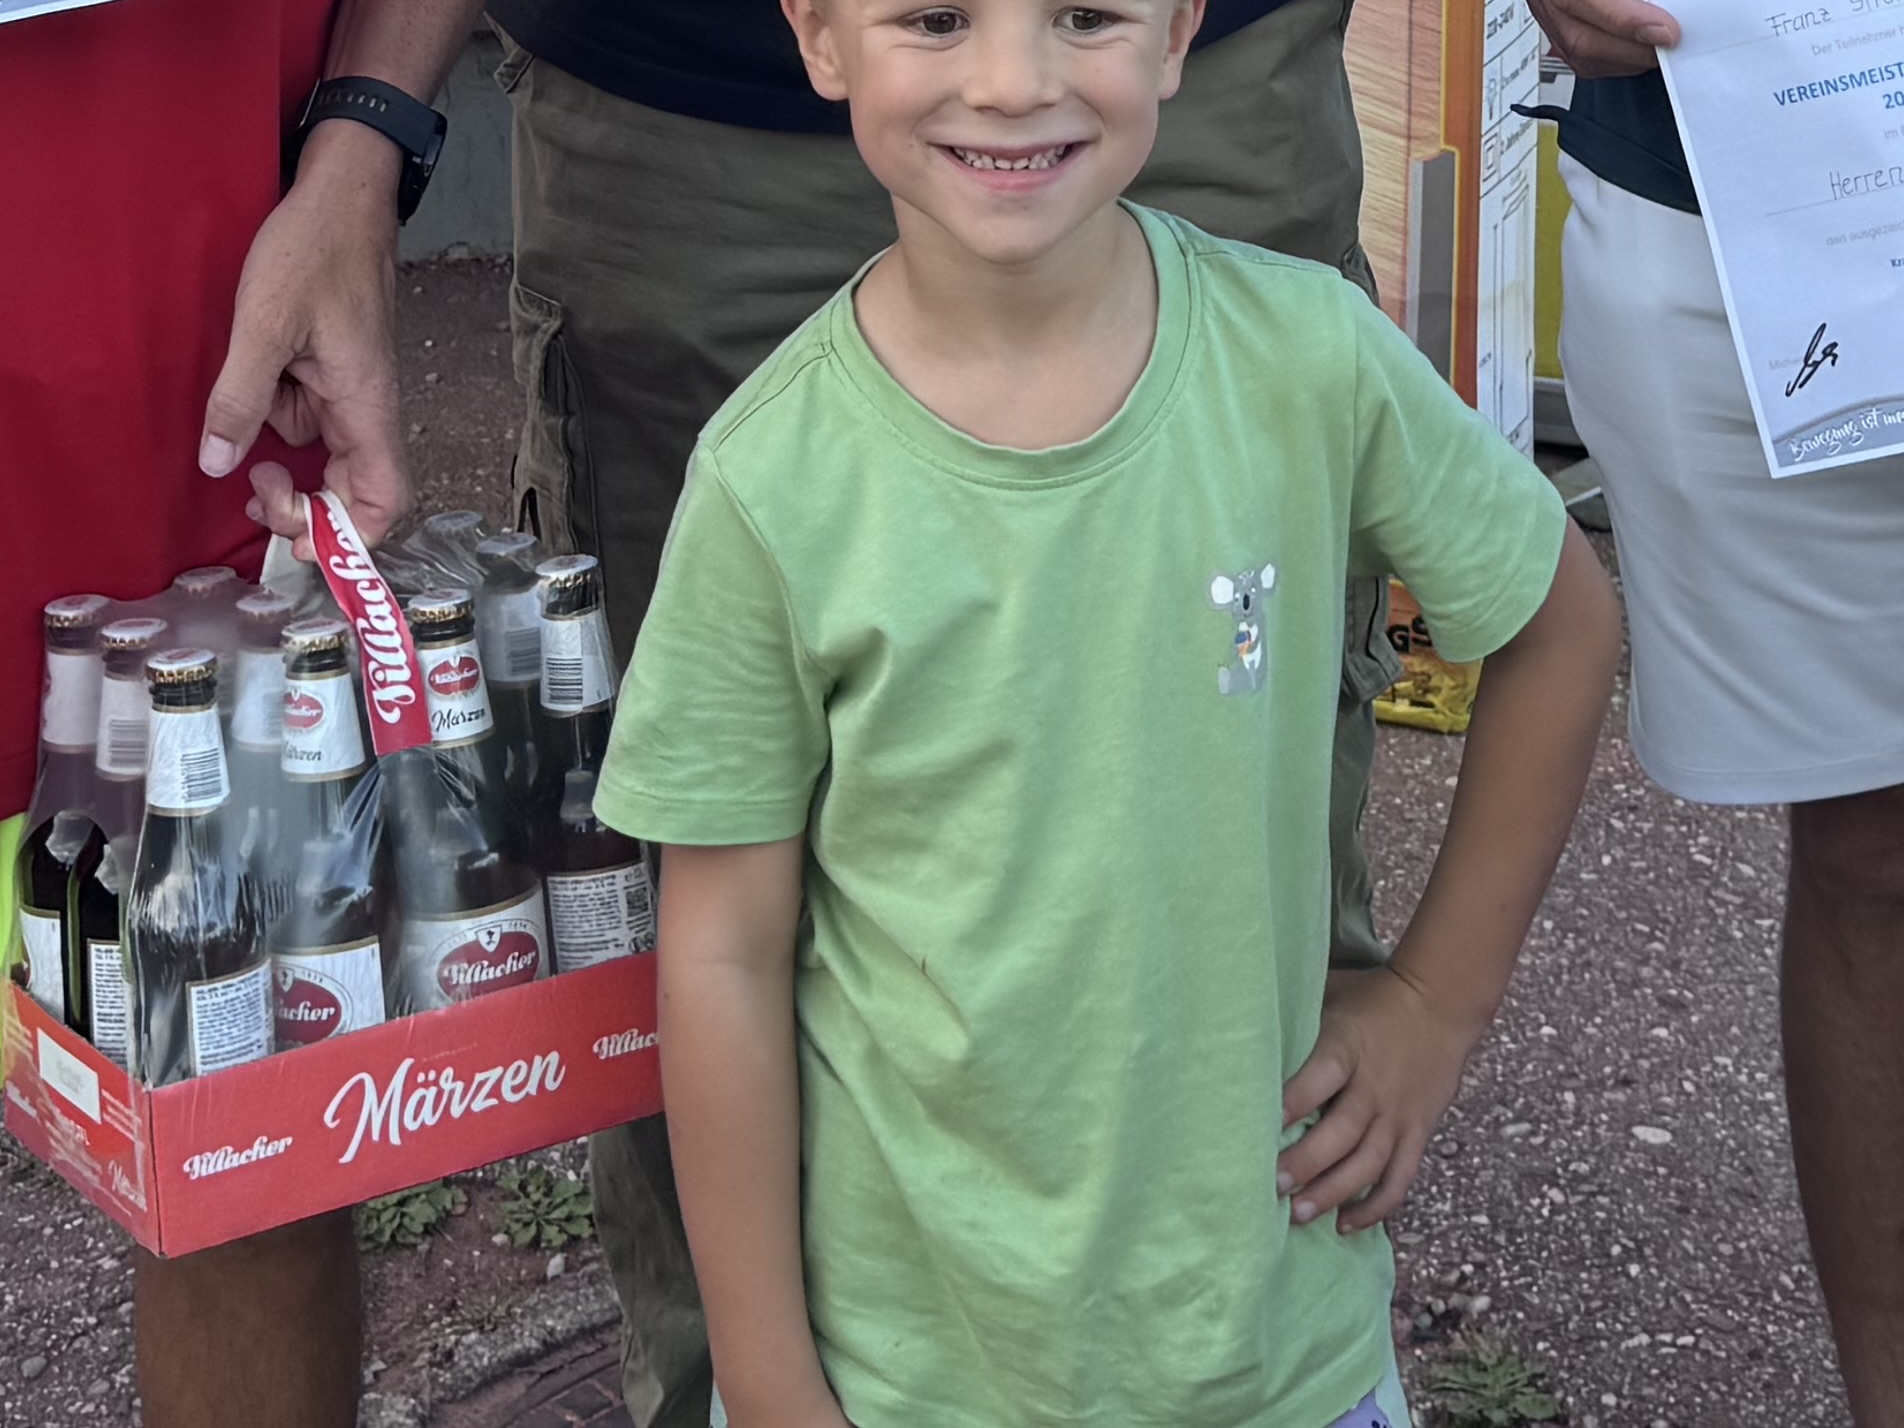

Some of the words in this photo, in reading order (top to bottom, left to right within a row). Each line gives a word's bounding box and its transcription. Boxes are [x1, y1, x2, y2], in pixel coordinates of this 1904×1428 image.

[1765, 7, 1833, 37] Franz
[1811, 44, 1832, 56] Der
[1835, 28, 1897, 52] Teilnehmer
[1860, 407, 1882, 430] ist
[592, 1028, 659, 1060] Villac
[323, 1049, 566, 1165] Märzen
[183, 1134, 294, 1180] Villacher
